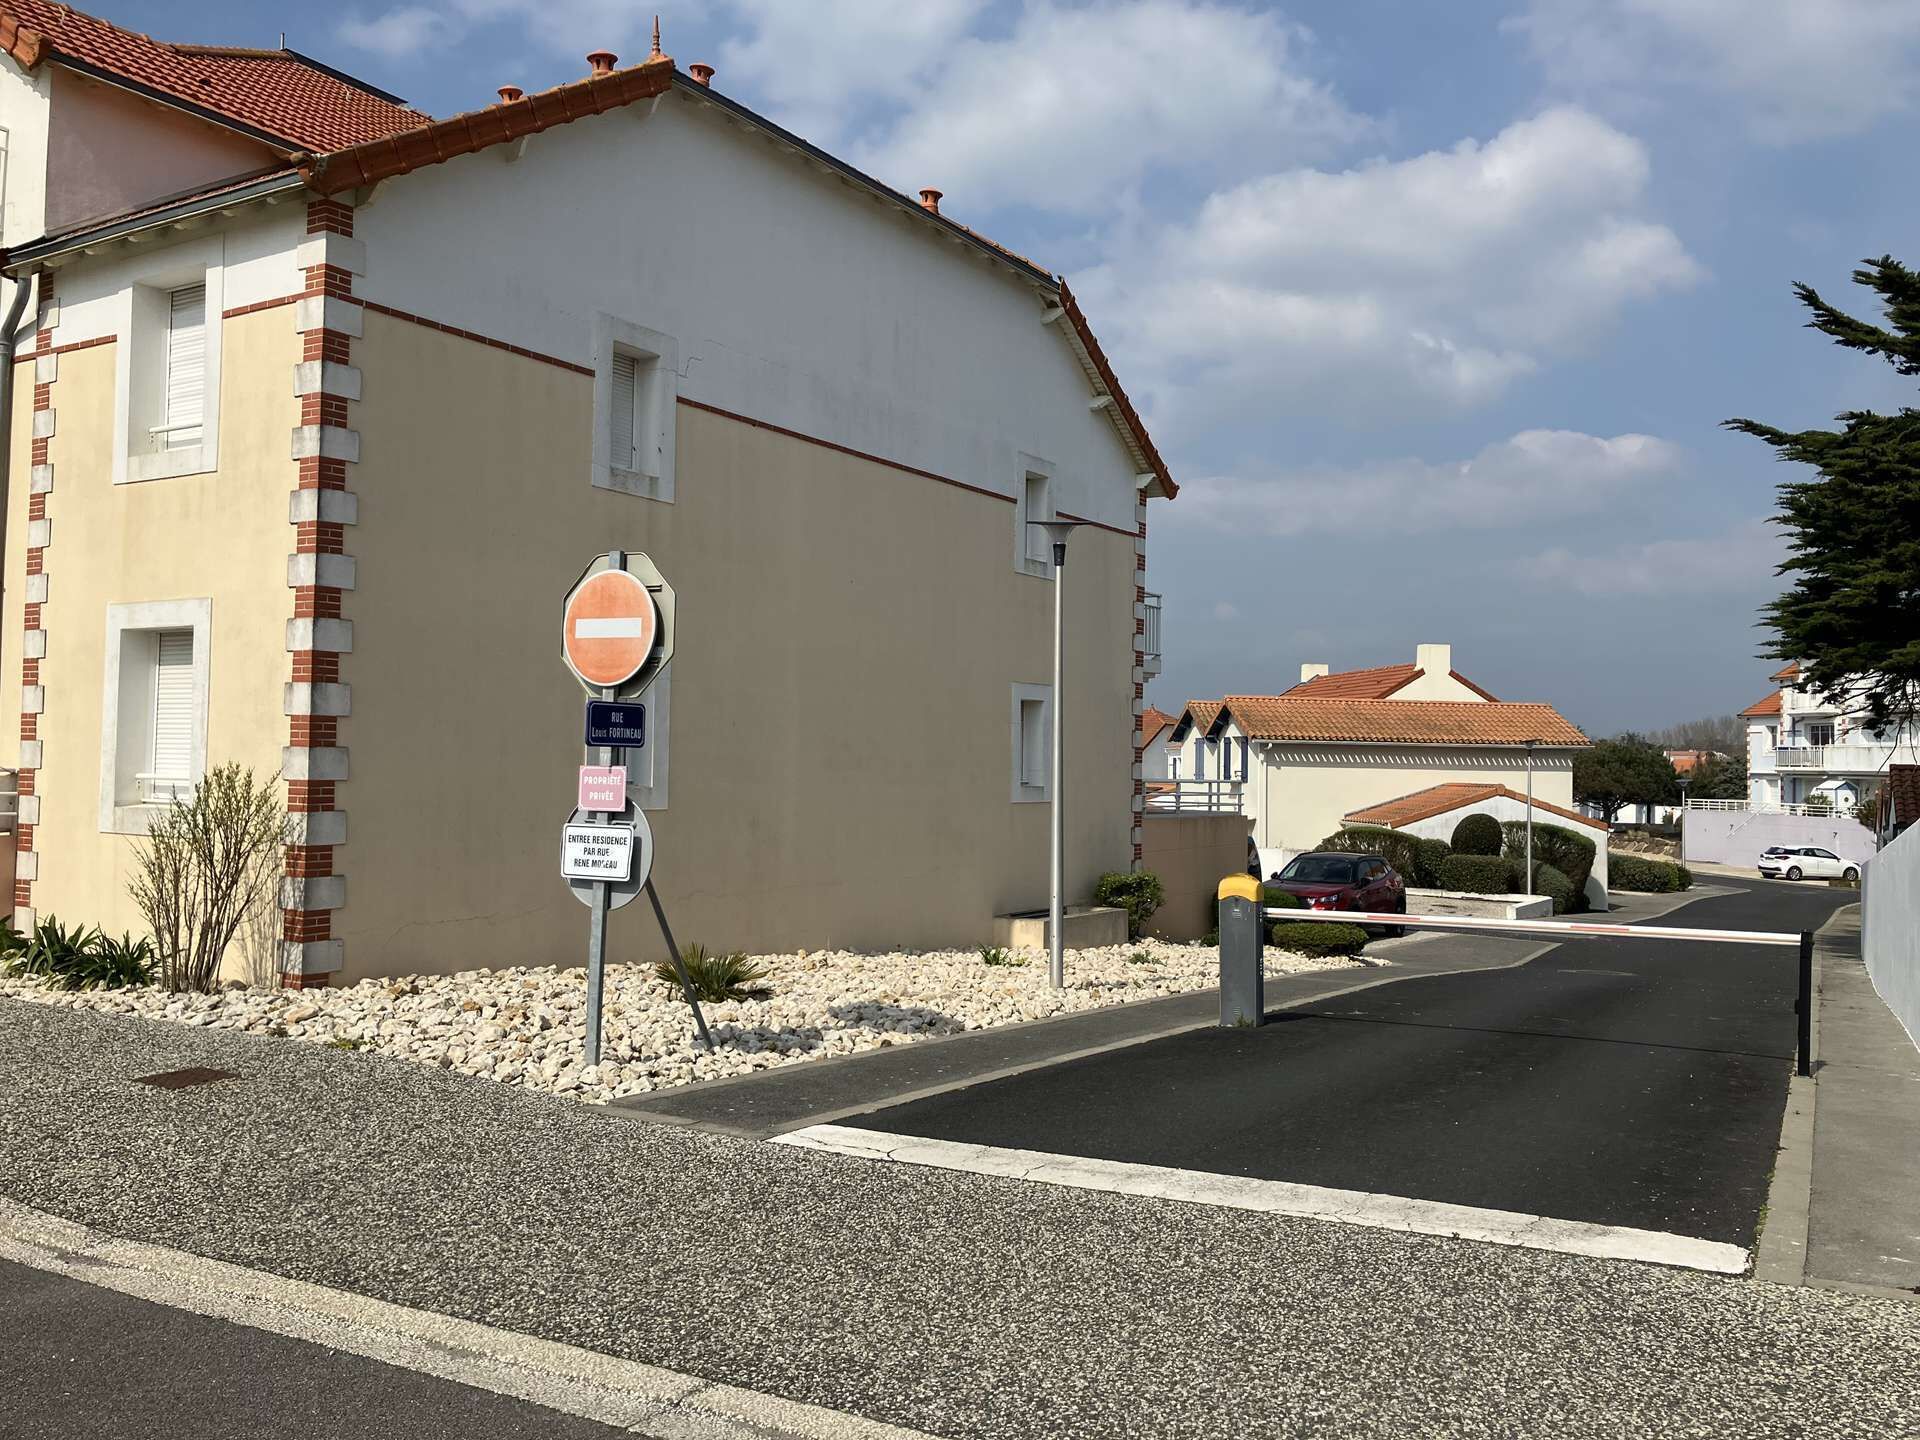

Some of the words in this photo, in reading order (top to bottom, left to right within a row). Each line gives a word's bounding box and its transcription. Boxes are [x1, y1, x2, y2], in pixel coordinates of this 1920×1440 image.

[611, 711, 624, 723] RUE
[609, 727, 641, 739] FORTINEAU
[583, 847, 596, 856] PAR
[597, 847, 610, 857] RUE
